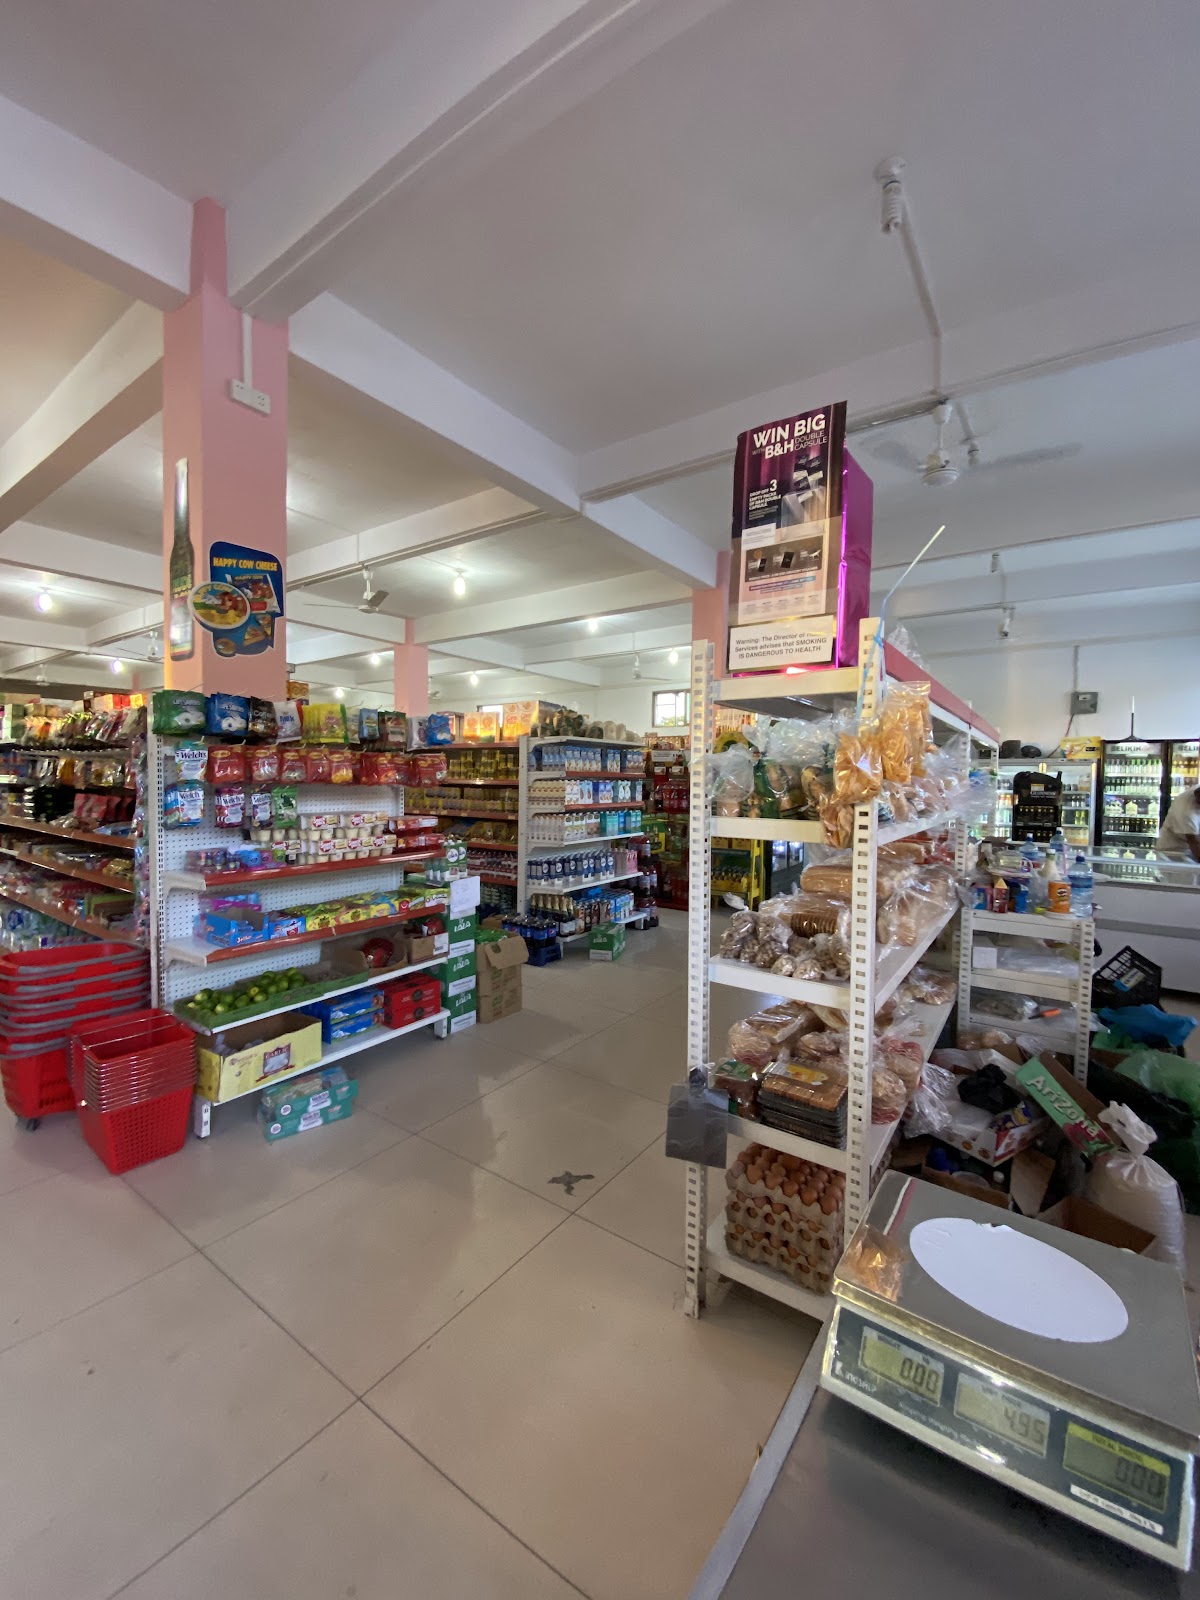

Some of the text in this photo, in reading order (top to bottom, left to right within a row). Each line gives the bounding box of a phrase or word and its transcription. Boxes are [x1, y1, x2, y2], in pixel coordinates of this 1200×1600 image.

[753, 413, 825, 448] WIN BIG
[765, 439, 794, 459] B&H
[794, 430, 825, 444] DOUBLE
[794, 436, 828, 451] CAPSULE
[770, 479, 777, 491] 3
[213, 557, 278, 571] HAPPY COW CHEESE
[735, 644, 758, 652] Services
[759, 642, 781, 650] advises
[796, 637, 827, 646] SMOKING
[736, 637, 760, 645] Warning:
[773, 633, 797, 641] Director
[746, 649, 784, 658] DANGEROUS
[795, 645, 821, 653] HEALTH
[180, 750, 207, 759] Welch's
